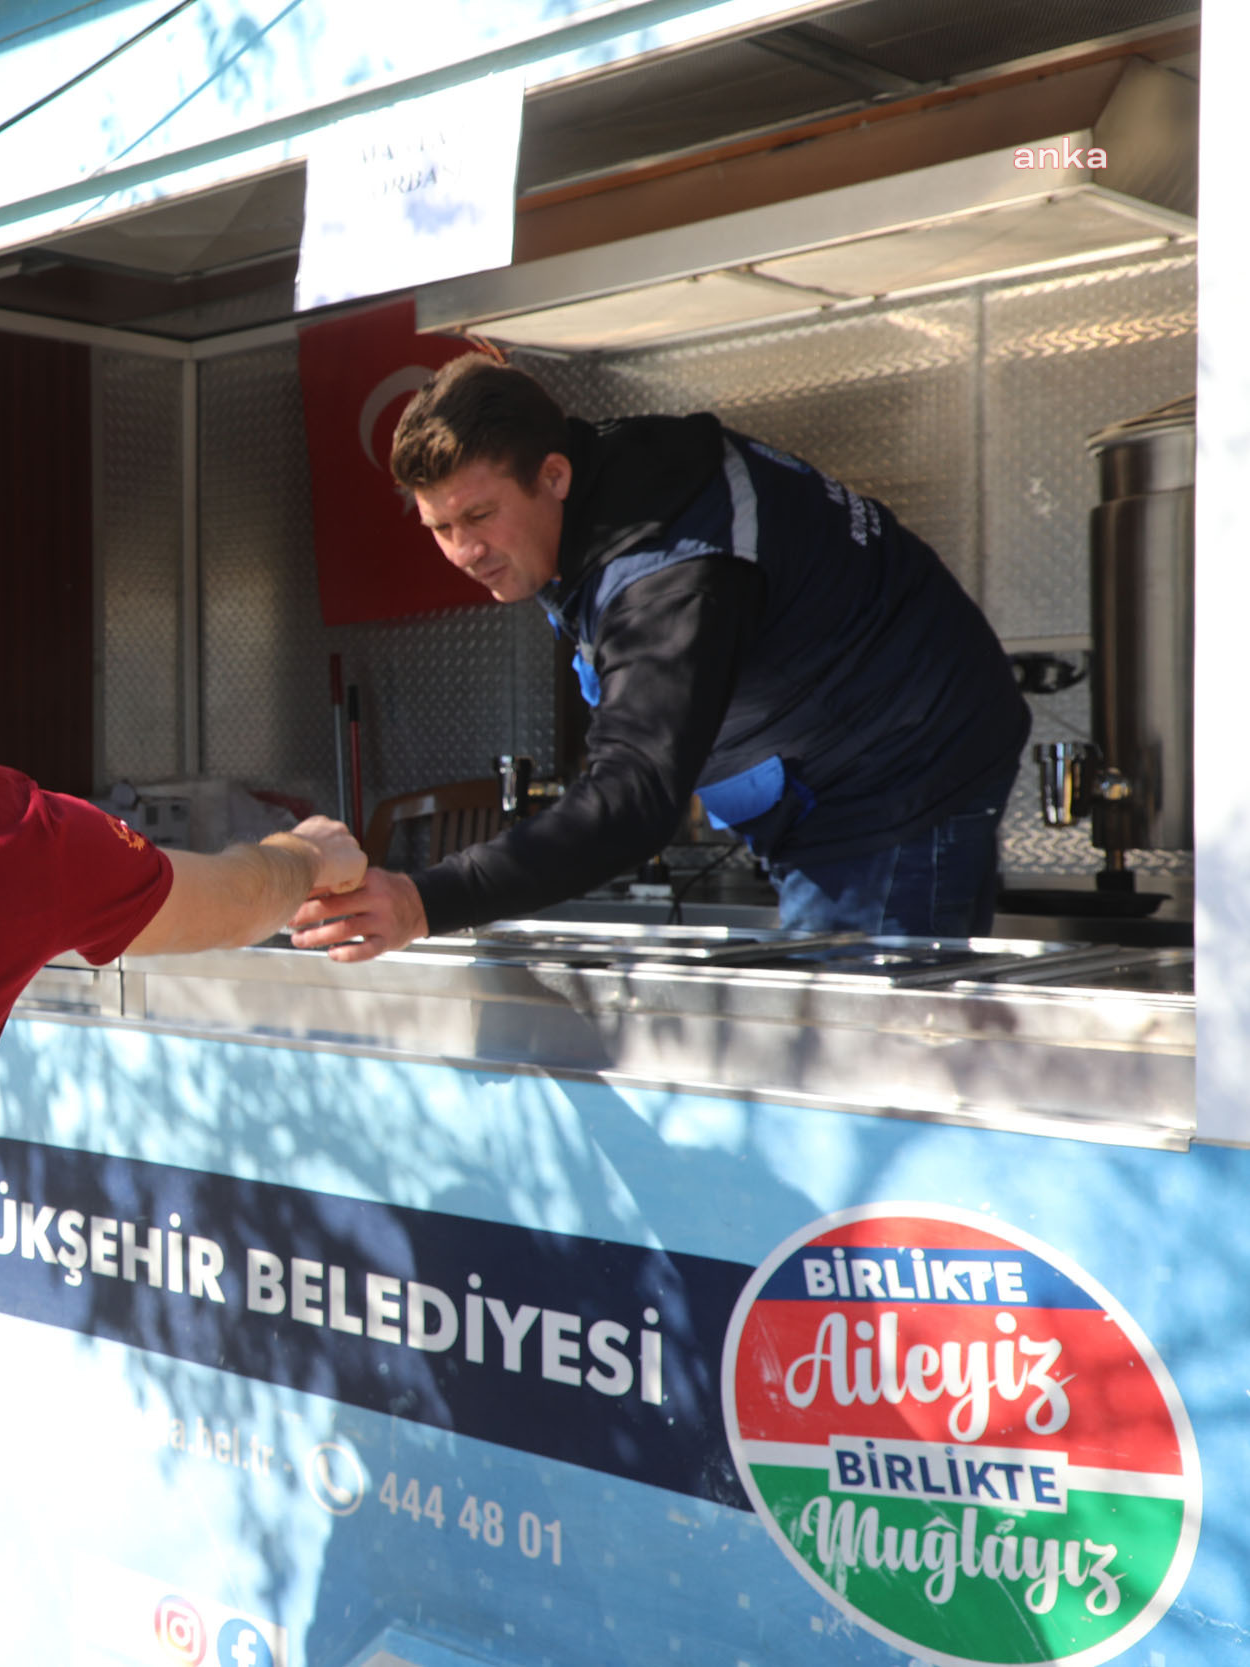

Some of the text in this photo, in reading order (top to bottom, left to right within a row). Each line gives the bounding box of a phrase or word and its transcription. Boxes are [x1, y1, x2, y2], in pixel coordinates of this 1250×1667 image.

[802, 1247, 1029, 1303] BİRLİKTE
[247, 1247, 664, 1406] BELEDİYESİ
[783, 1311, 1076, 1443] Aileyiz
[379, 1472, 445, 1529] 444
[458, 1495, 505, 1547] 48
[519, 1511, 562, 1566] 01
[835, 1440, 1062, 1505] BİRLİKTE
